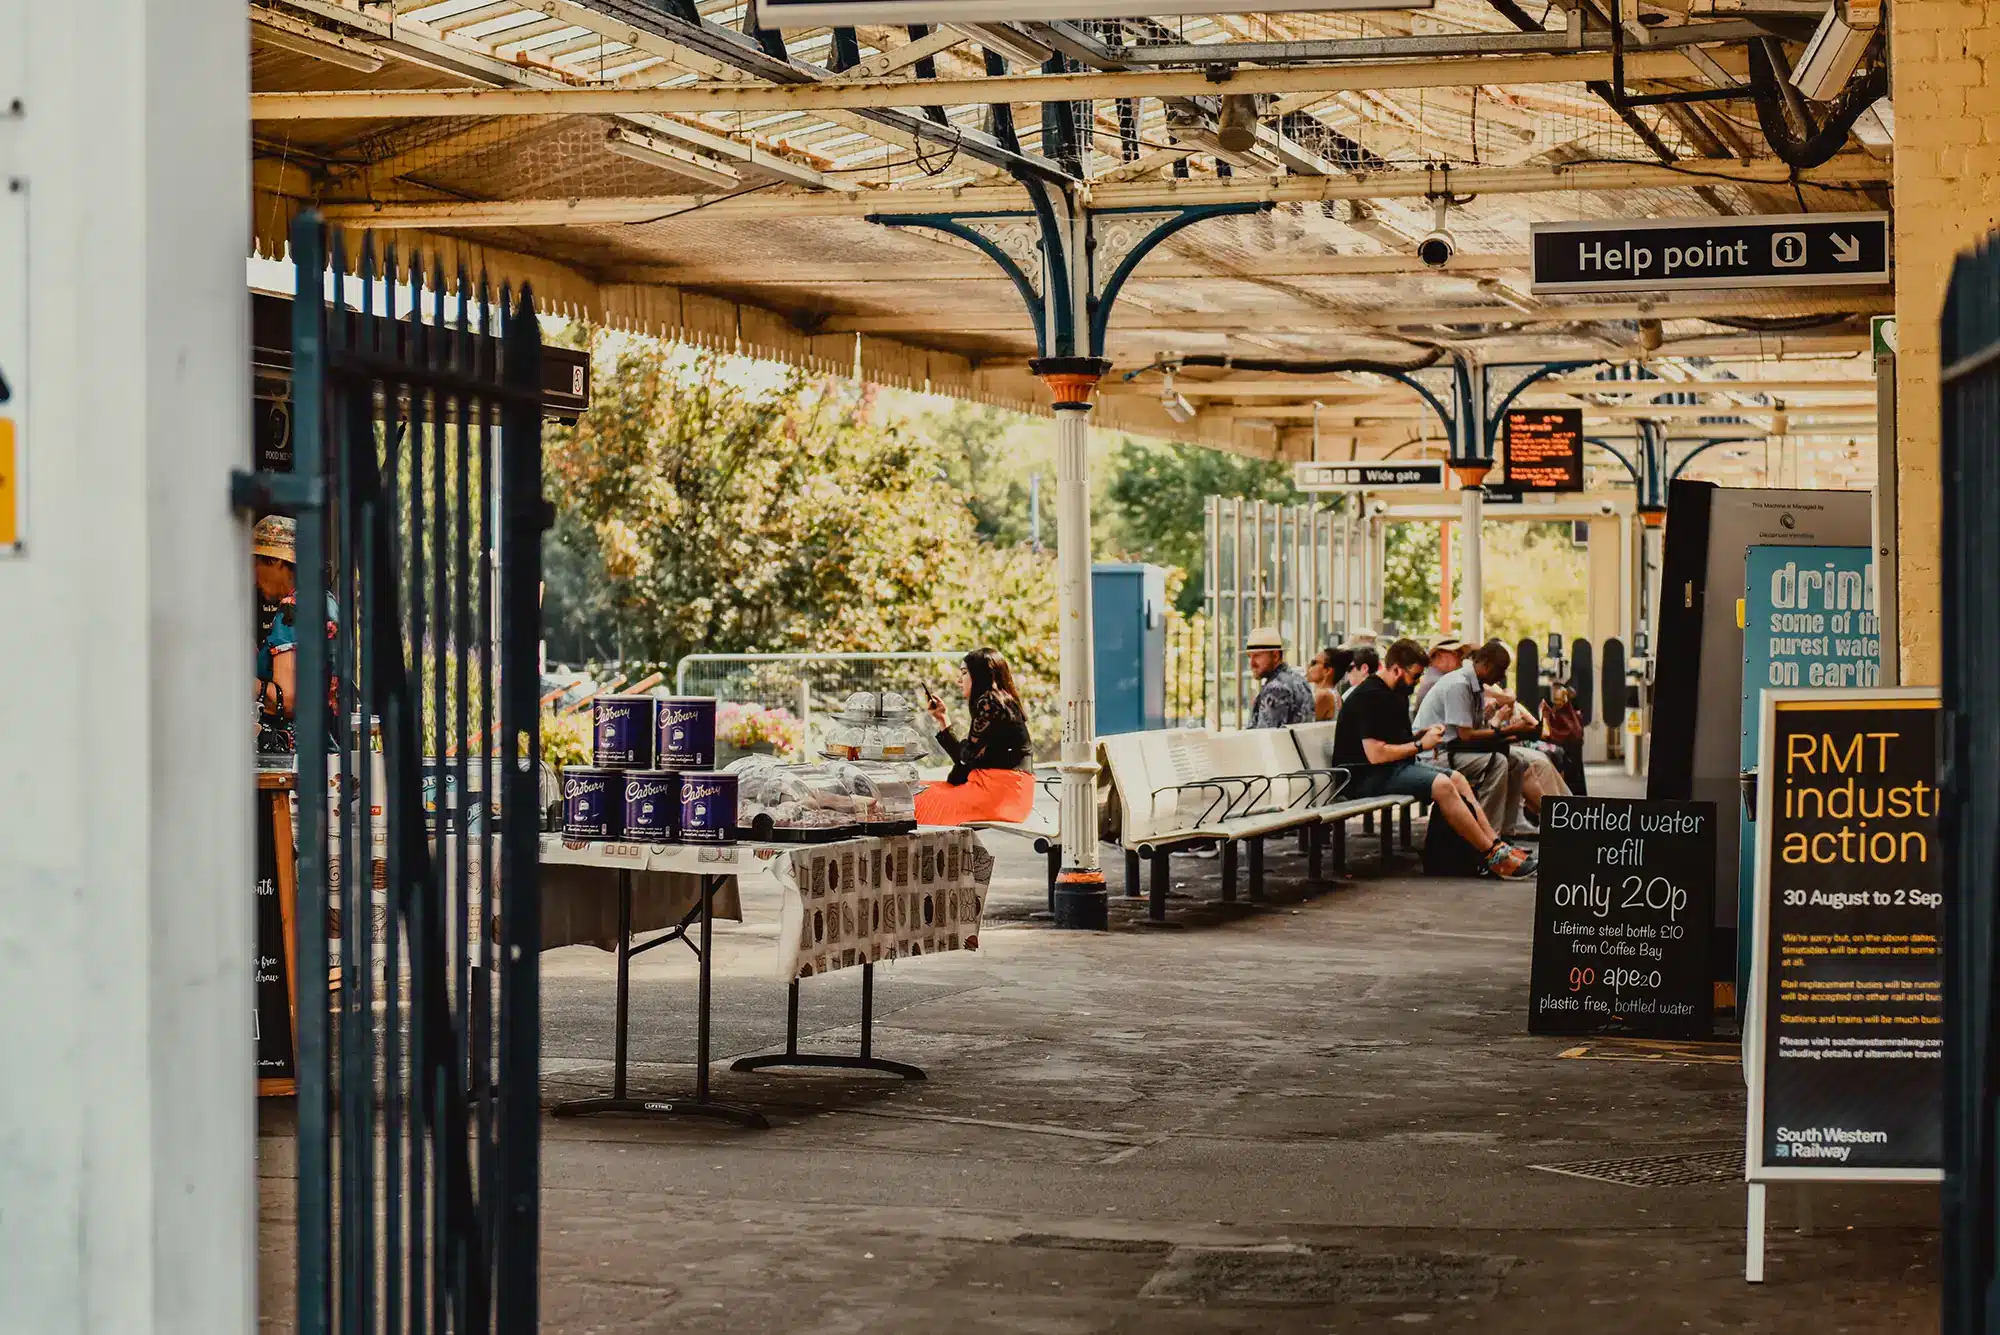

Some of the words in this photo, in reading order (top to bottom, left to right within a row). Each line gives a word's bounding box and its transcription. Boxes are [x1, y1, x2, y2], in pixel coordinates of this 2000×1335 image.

[1579, 241, 1652, 276] Help
[1664, 239, 1748, 275] point
[1366, 470, 1394, 481] Wide
[1396, 470, 1421, 482] gate
[1770, 613, 1824, 633] some
[1831, 611, 1851, 634] of
[1858, 612, 1880, 635] th
[1770, 635, 1828, 658] purest
[1835, 636, 1880, 657] wate
[1769, 661, 1799, 686] on
[1809, 659, 1880, 687] earth
[594, 705, 631, 727] Cadbury
[658, 708, 698, 729] Cadbury
[1787, 732, 1900, 774] RMT
[564, 778, 605, 800] Cadbury
[625, 781, 668, 803] Cadbury
[680, 782, 721, 805] Cadbury
[1551, 801, 1633, 832] Bottled
[1640, 810, 1705, 834] water
[1597, 838, 1645, 866] refill
[1782, 821, 1928, 864] action
[1554, 873, 1611, 918] only
[1620, 875, 1688, 922] 20p
[1783, 889, 1807, 906] 30
[1809, 889, 1870, 909] August
[1873, 890, 1891, 905] to
[1894, 889, 1906, 905] 2
[1553, 920, 1596, 936] Lifetime
[1598, 923, 1624, 937] steel
[1626, 924, 1657, 939] bottle
[1660, 925, 1684, 940] £10
[1865, 934, 1880, 942] the
[1882, 934, 1908, 942] above
[1572, 940, 1597, 954] from
[1600, 941, 1636, 956] Coffee
[1639, 942, 1663, 961] Bay
[1892, 946, 1910, 954] and
[1569, 967, 1595, 992] go
[1540, 994, 1579, 1013] plastic
[1584, 996, 1611, 1015] free,
[1615, 998, 1656, 1013] bottled
[1660, 1002, 1695, 1015] water
[1906, 992, 1924, 1001] and
[1864, 1015, 1879, 1023] will
[1780, 1037, 1810, 1045] Please
[1811, 1037, 1830, 1045] visit
[1780, 1049, 1821, 1059] including
[1822, 1049, 1852, 1058] details
[1853, 1050, 1864, 1058] of
[1864, 1050, 1913, 1058] alternative
[1915, 1050, 1941, 1058] travel
[1777, 1127, 1822, 1142] South
[1823, 1128, 1887, 1143] Western
[1792, 1143, 1850, 1162] Railway
